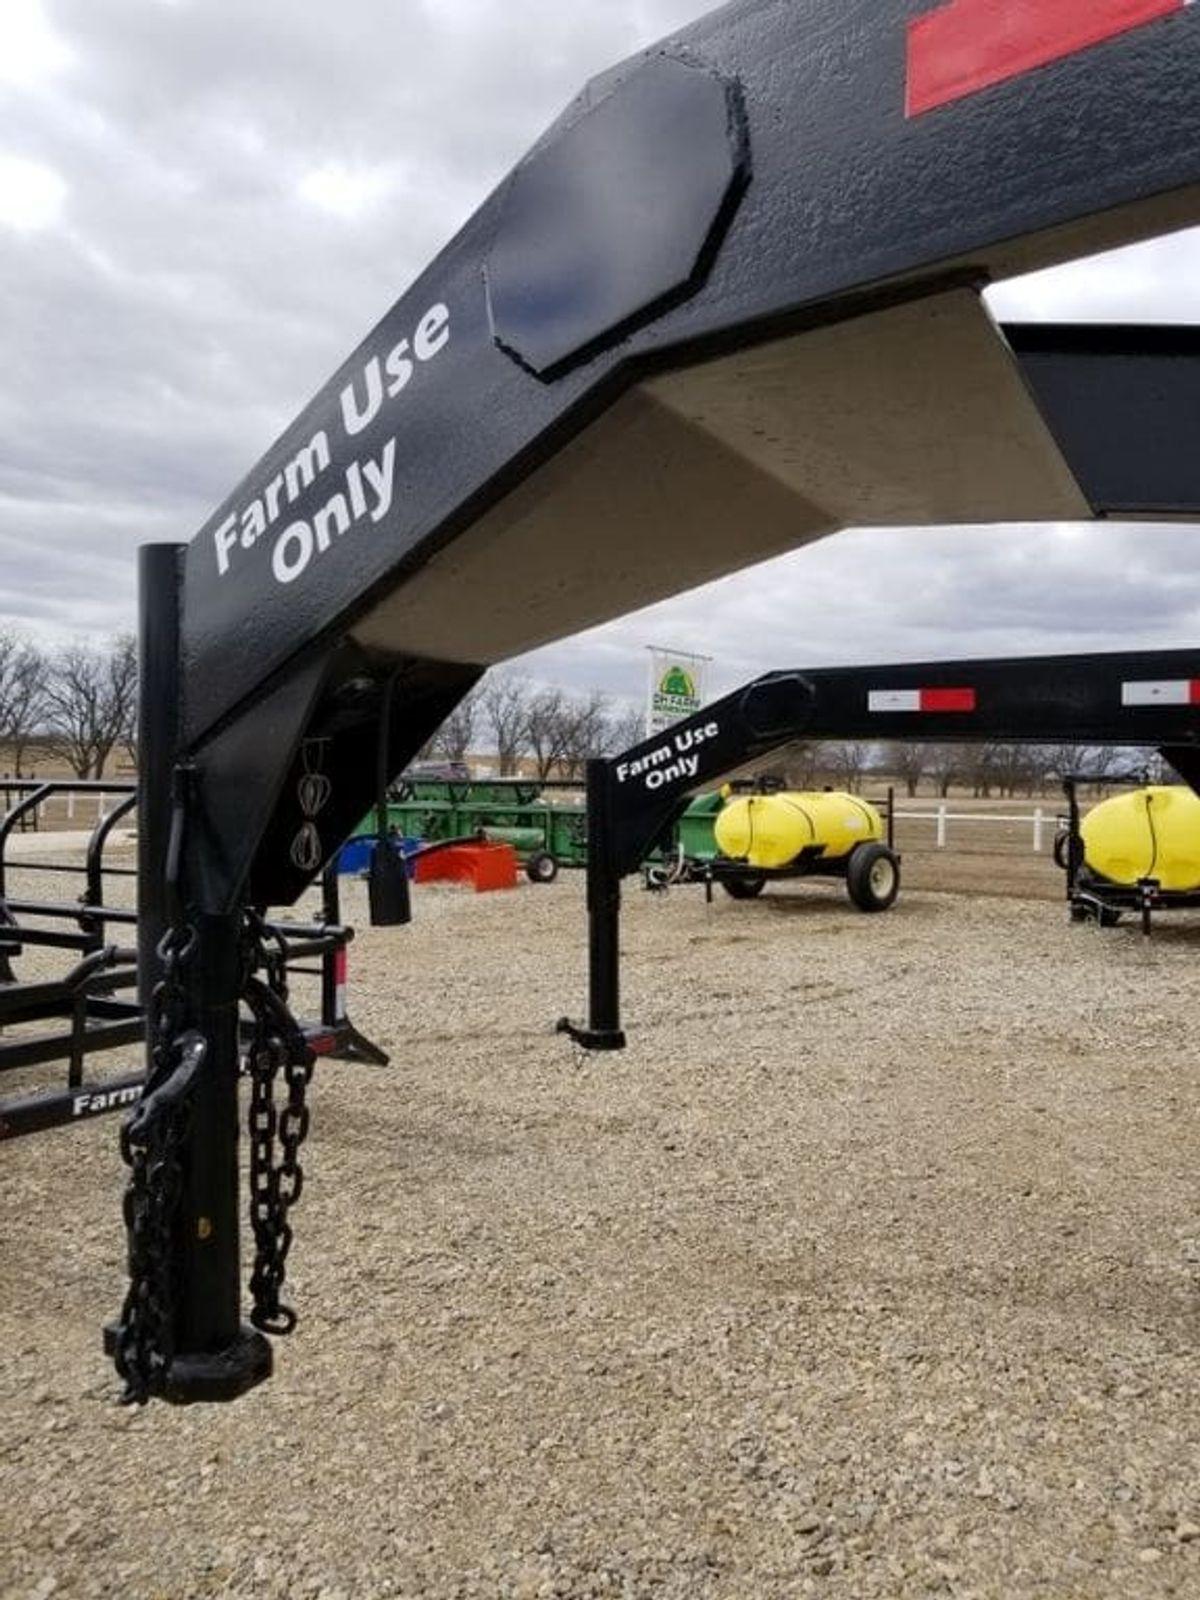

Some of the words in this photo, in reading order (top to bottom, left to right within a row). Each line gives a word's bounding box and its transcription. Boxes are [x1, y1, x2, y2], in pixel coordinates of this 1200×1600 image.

[213, 430, 331, 576] Farm
[339, 302, 450, 435] Use
[271, 436, 396, 583] Only
[616, 745, 672, 782] Farm
[675, 722, 719, 751] Use
[645, 754, 699, 789] Only
[72, 1085, 144, 1115] Farm
